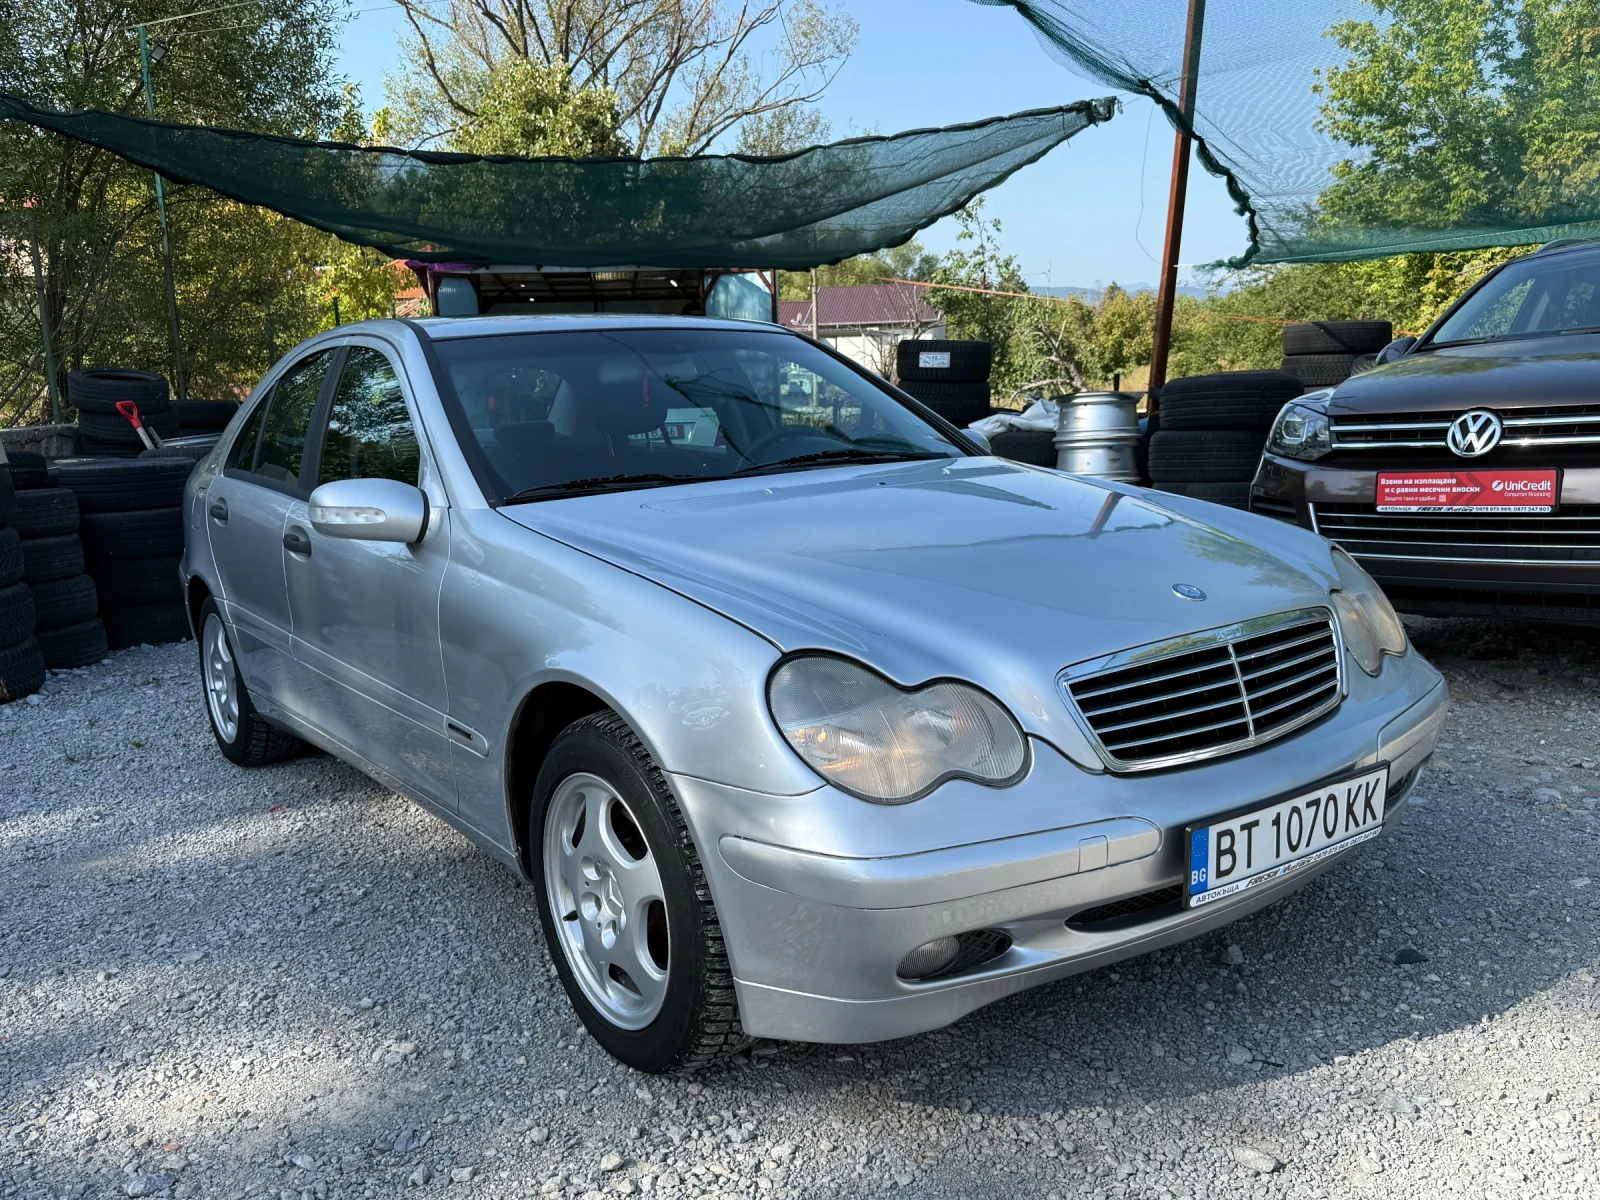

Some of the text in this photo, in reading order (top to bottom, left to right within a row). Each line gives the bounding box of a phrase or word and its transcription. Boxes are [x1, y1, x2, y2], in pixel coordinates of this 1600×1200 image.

[1414, 478, 1457, 486] изплащане
[1504, 480, 1552, 491] UniCredit
[1396, 487, 1418, 495] равни
[1215, 777, 1381, 880] BT 1070 KK
[1191, 868, 1207, 886] BG
[1195, 884, 1240, 904] АВТОКЪЩА
[1245, 868, 1281, 888] FRESH
